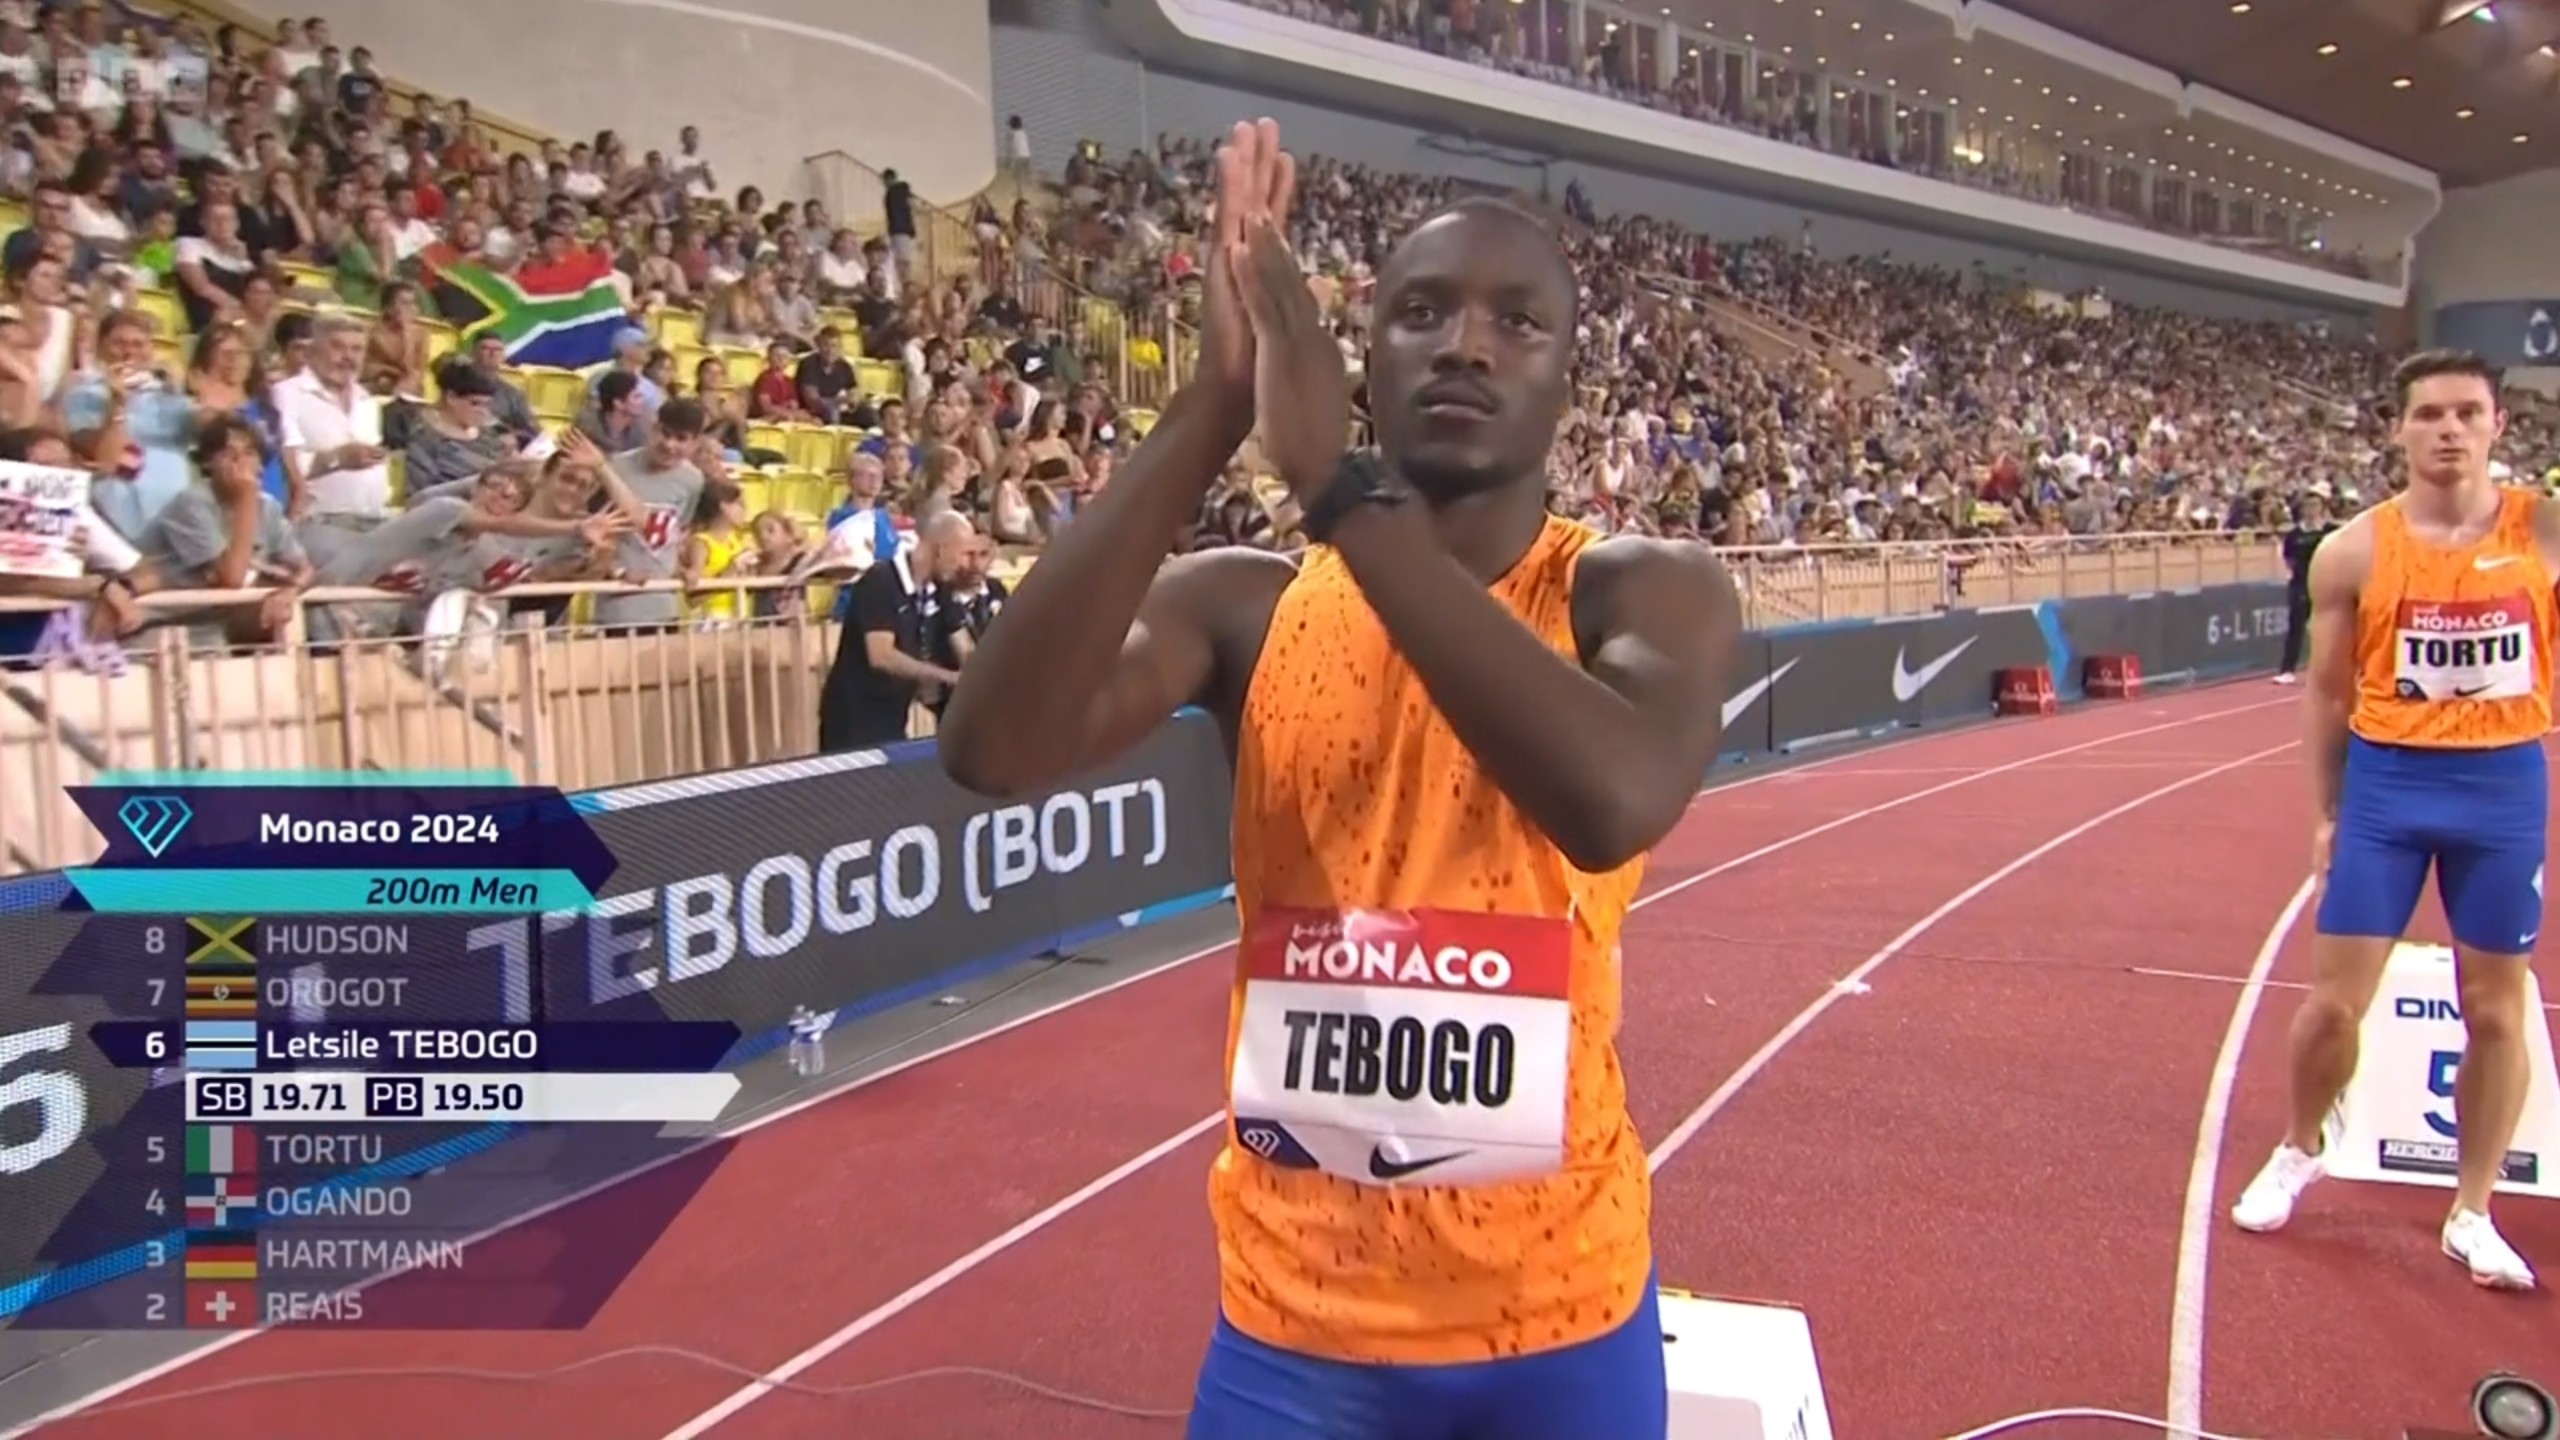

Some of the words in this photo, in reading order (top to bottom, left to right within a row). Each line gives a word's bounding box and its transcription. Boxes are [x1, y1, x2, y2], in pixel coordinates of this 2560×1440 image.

[2208, 615, 2219, 644] 6
[2412, 611, 2508, 630] MONACO
[2404, 632, 2520, 668] TORTU
[466, 822, 940, 1024] TEBOGO
[963, 778, 1168, 912] (BOT)
[1284, 940, 1512, 988] MONACO
[1284, 1010, 1516, 1108] TEBOGO
